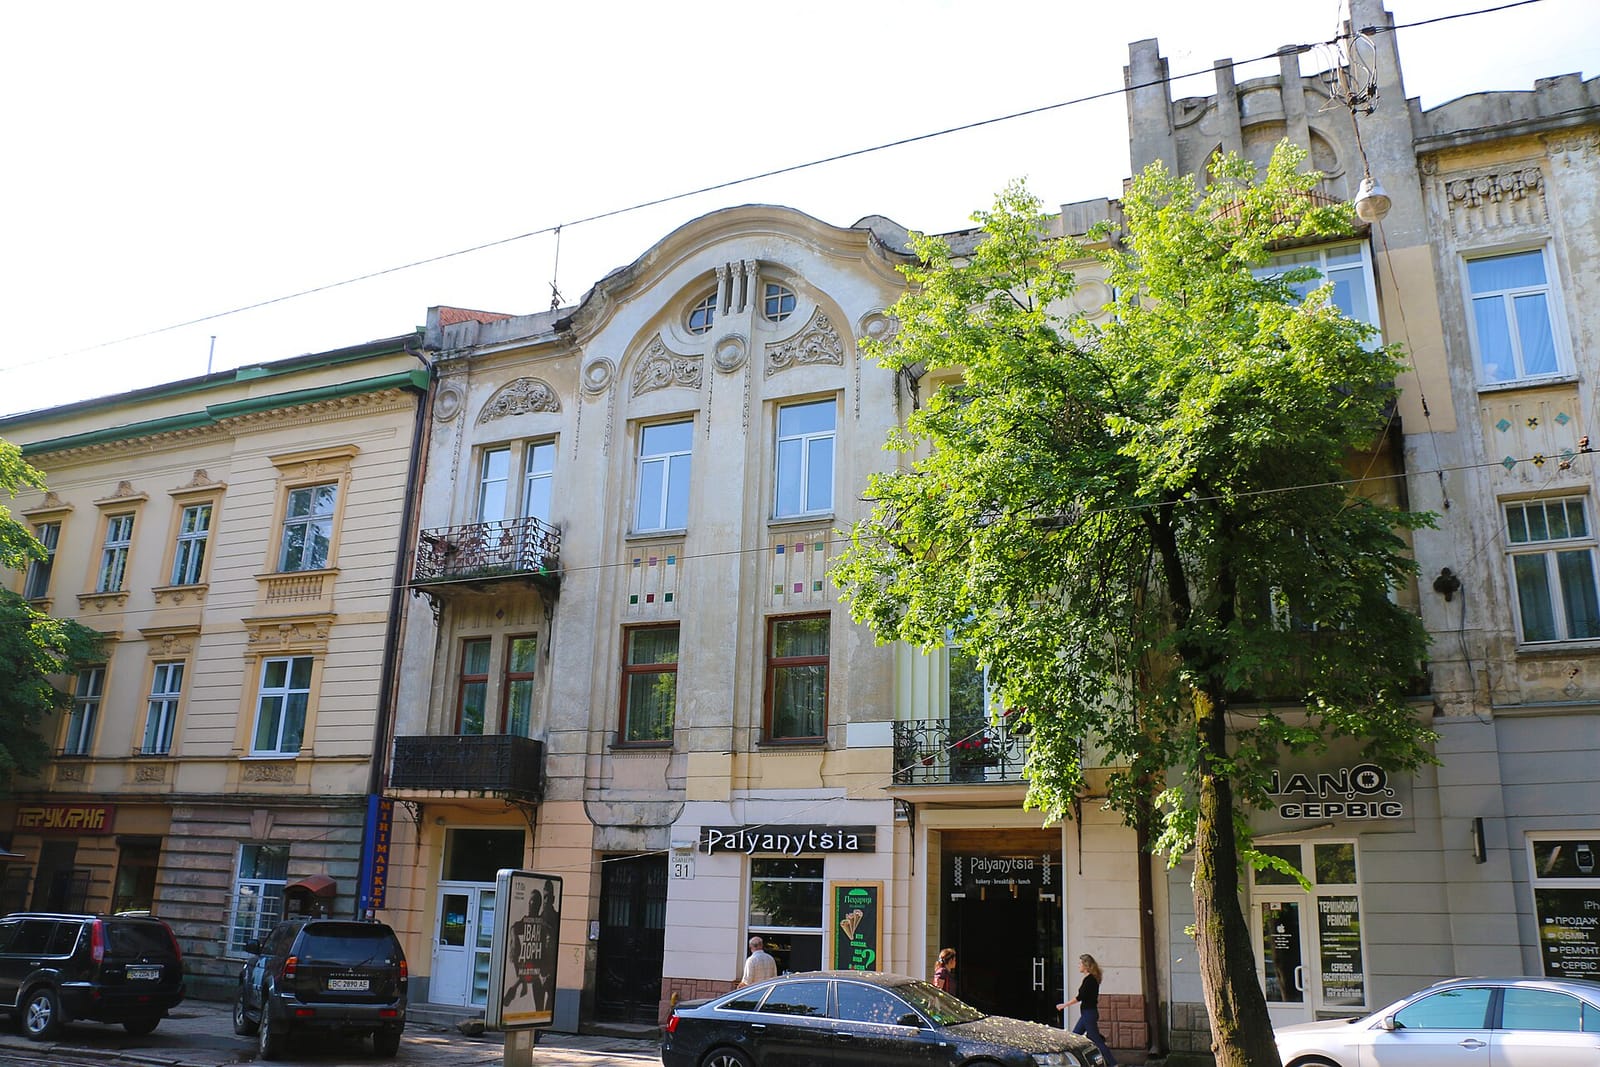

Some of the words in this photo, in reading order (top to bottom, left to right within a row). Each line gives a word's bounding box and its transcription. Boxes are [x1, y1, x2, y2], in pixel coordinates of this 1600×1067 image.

[16, 807, 105, 829] ПЕРУКАРНЯ
[1280, 801, 1403, 819] СЕРВІС
[708, 829, 859, 856] Palyanytsia
[373, 801, 391, 907] МІНІМАРКЕТ
[675, 863, 689, 878] 31
[970, 856, 1034, 875] Palyanytsia
[1327, 914, 1352, 927] РЕМОНТ
[1555, 916, 1599, 926] ПРОДАЖ
[523, 923, 542, 942] ІВАН
[1557, 931, 1589, 940] ОБМІН
[518, 942, 542, 963] ДОРН
[1560, 946, 1600, 955] РЕМОНТ
[1561, 961, 1597, 970] СЕРВІС
